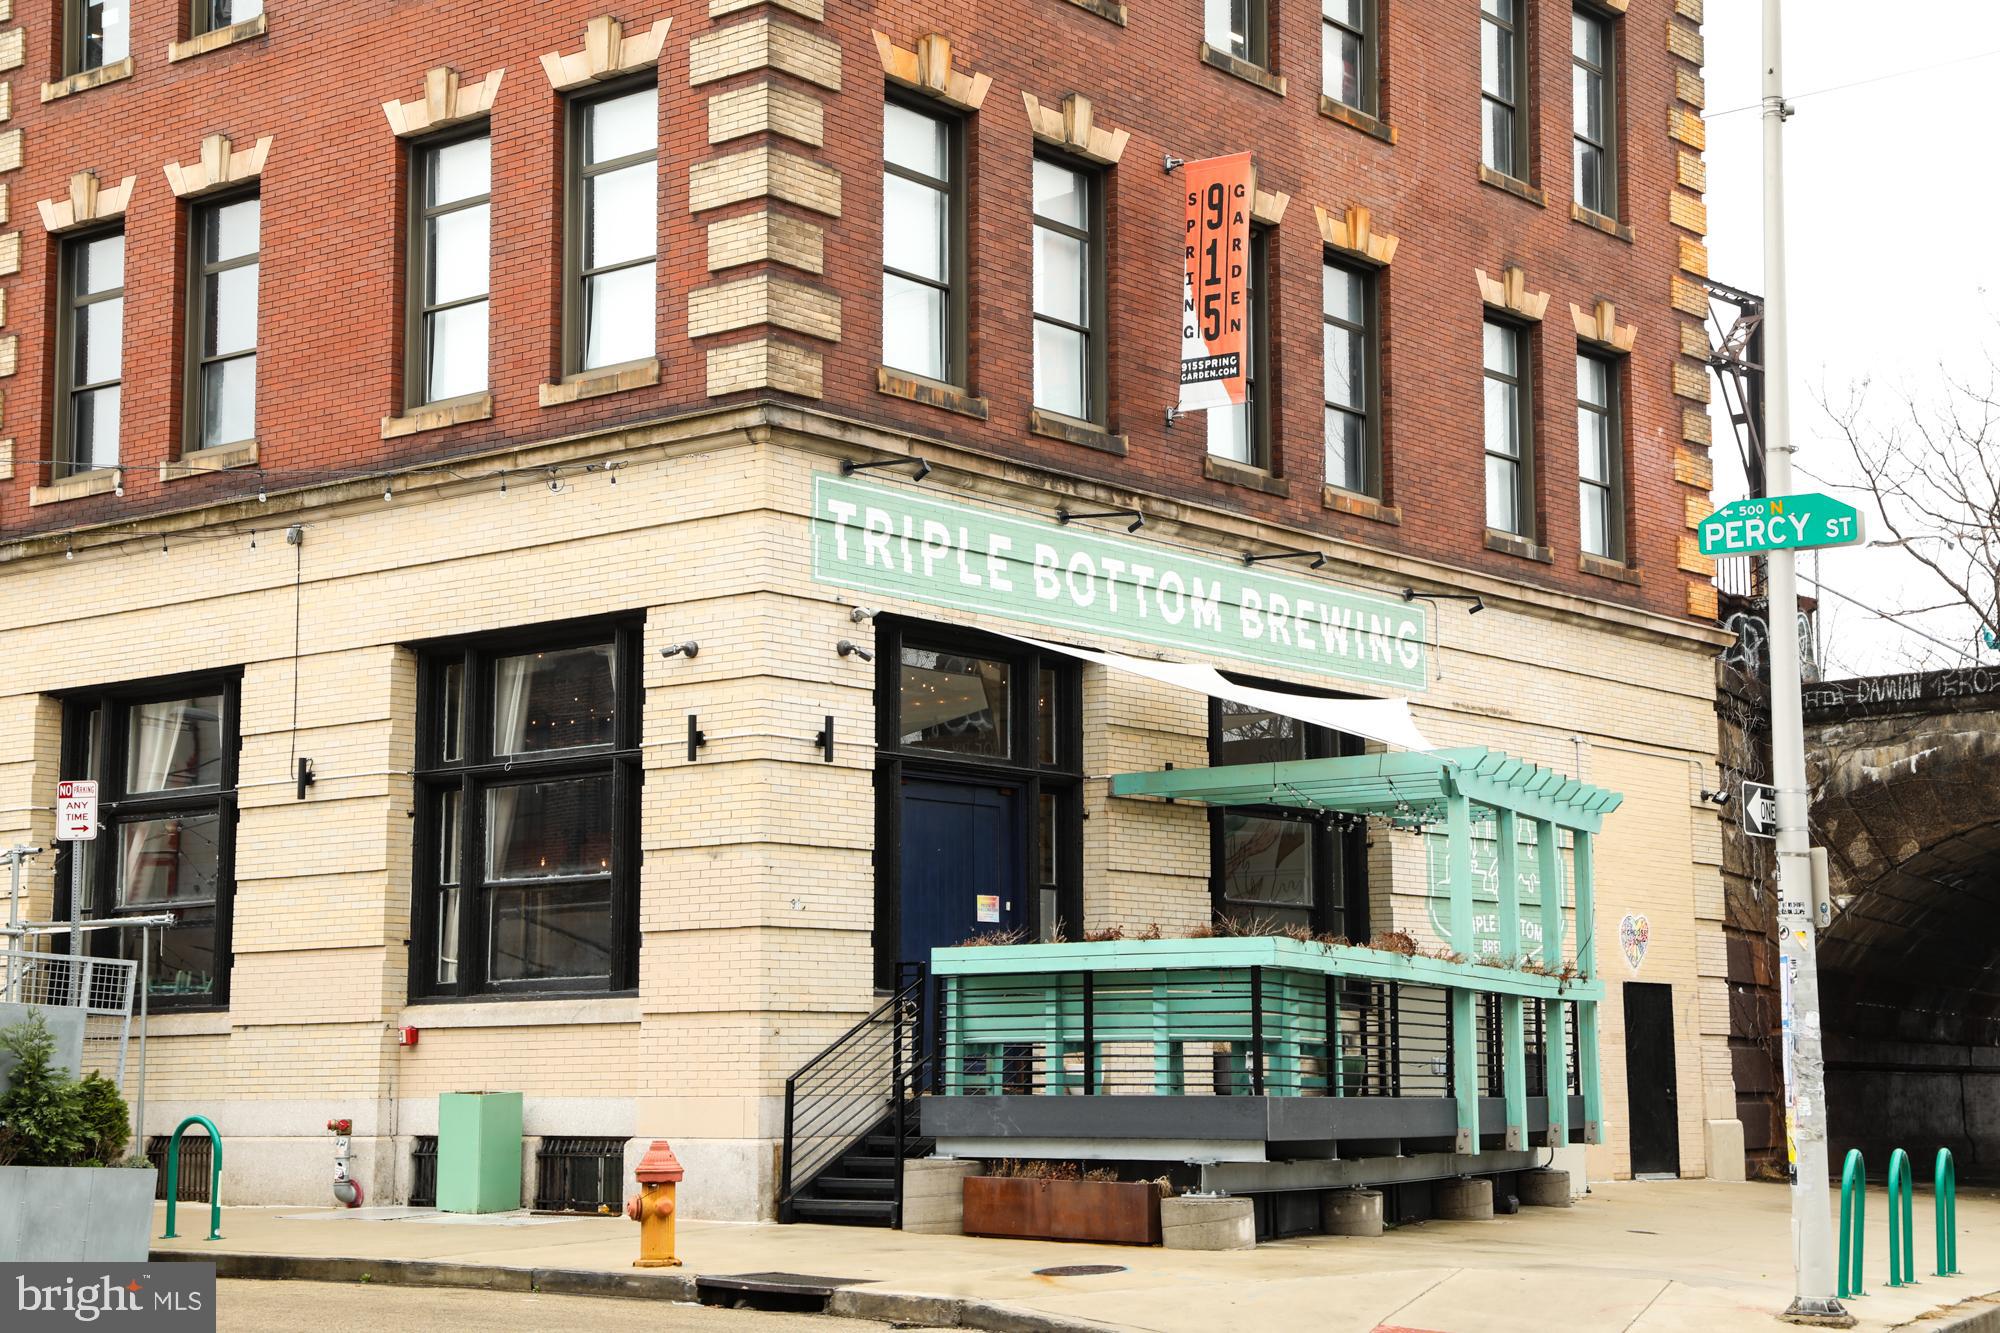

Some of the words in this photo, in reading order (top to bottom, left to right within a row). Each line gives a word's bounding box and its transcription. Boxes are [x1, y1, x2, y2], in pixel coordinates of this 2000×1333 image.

[1183, 192, 1198, 339] SPRING
[1204, 182, 1224, 342] 915
[1231, 183, 1246, 334] GARDEN
[1181, 356, 1237, 372] 915SPRING
[1181, 367, 1237, 381] GARDEN.COM
[1738, 504, 1764, 517] 500
[1770, 500, 1784, 515] N
[1705, 512, 1811, 551] PERCY
[1826, 516, 1852, 538] ST
[827, 498, 1013, 592] TRIPLE
[1033, 543, 1222, 632] BOTTOM
[1239, 587, 1423, 670] BREWING
[59, 784, 72, 797] NO
[66, 813, 89, 821] TIME
